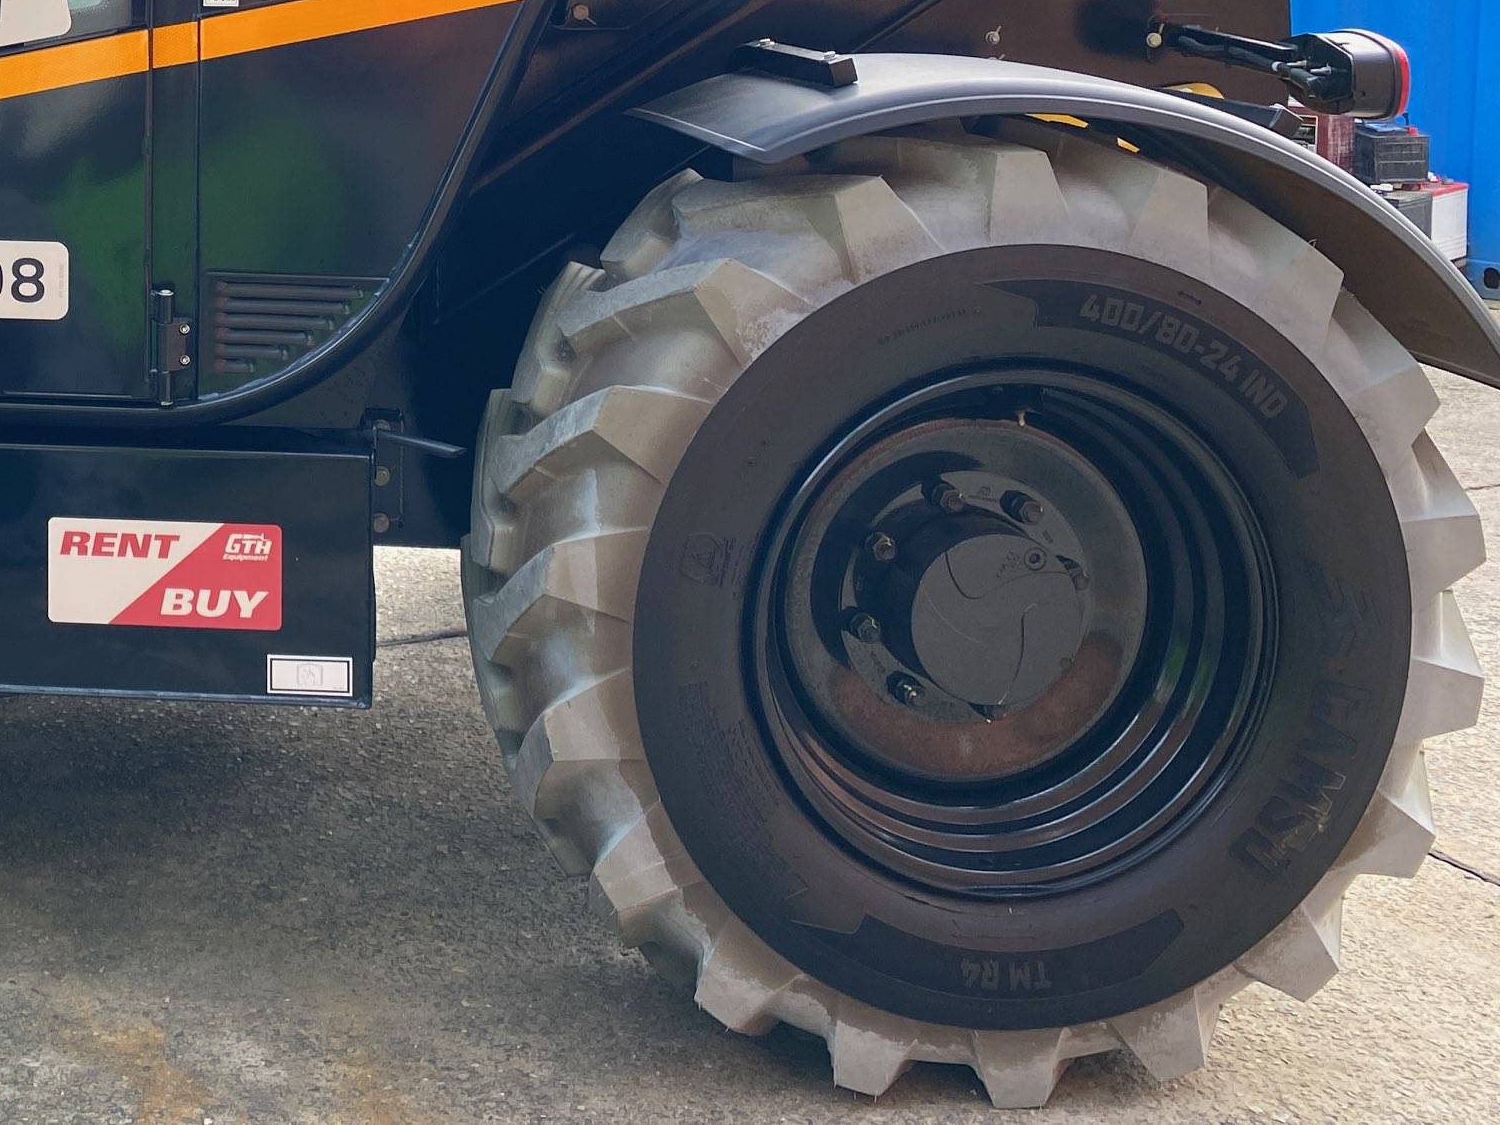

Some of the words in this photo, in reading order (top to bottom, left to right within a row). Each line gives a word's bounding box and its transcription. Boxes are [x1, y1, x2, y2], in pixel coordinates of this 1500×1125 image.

[1079, 293, 1243, 382] 400/80-24
[60, 530, 181, 560] RENT
[223, 553, 269, 562] Equipment
[225, 533, 272, 556] GTH
[160, 587, 269, 619] BUY
